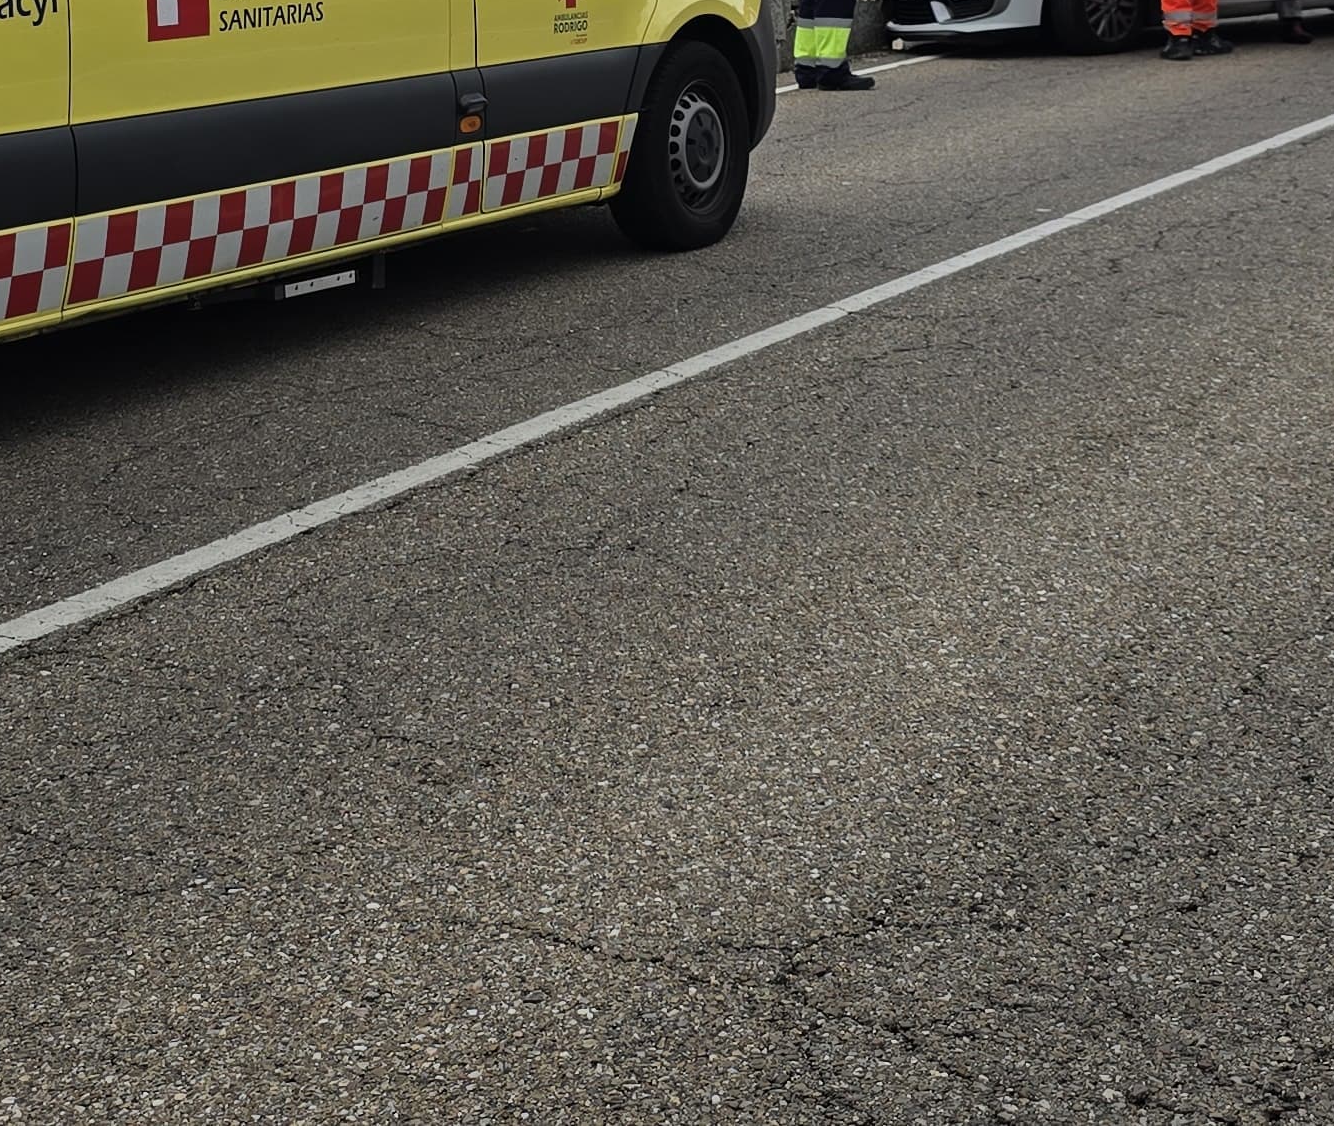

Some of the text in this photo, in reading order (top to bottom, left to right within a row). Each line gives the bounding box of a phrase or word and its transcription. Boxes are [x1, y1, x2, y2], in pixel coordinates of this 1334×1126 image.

[219, 1, 324, 32] SANITARIAS
[554, 11, 588, 22] AMBULANCIAS
[553, 19, 588, 34] RODRIGO
